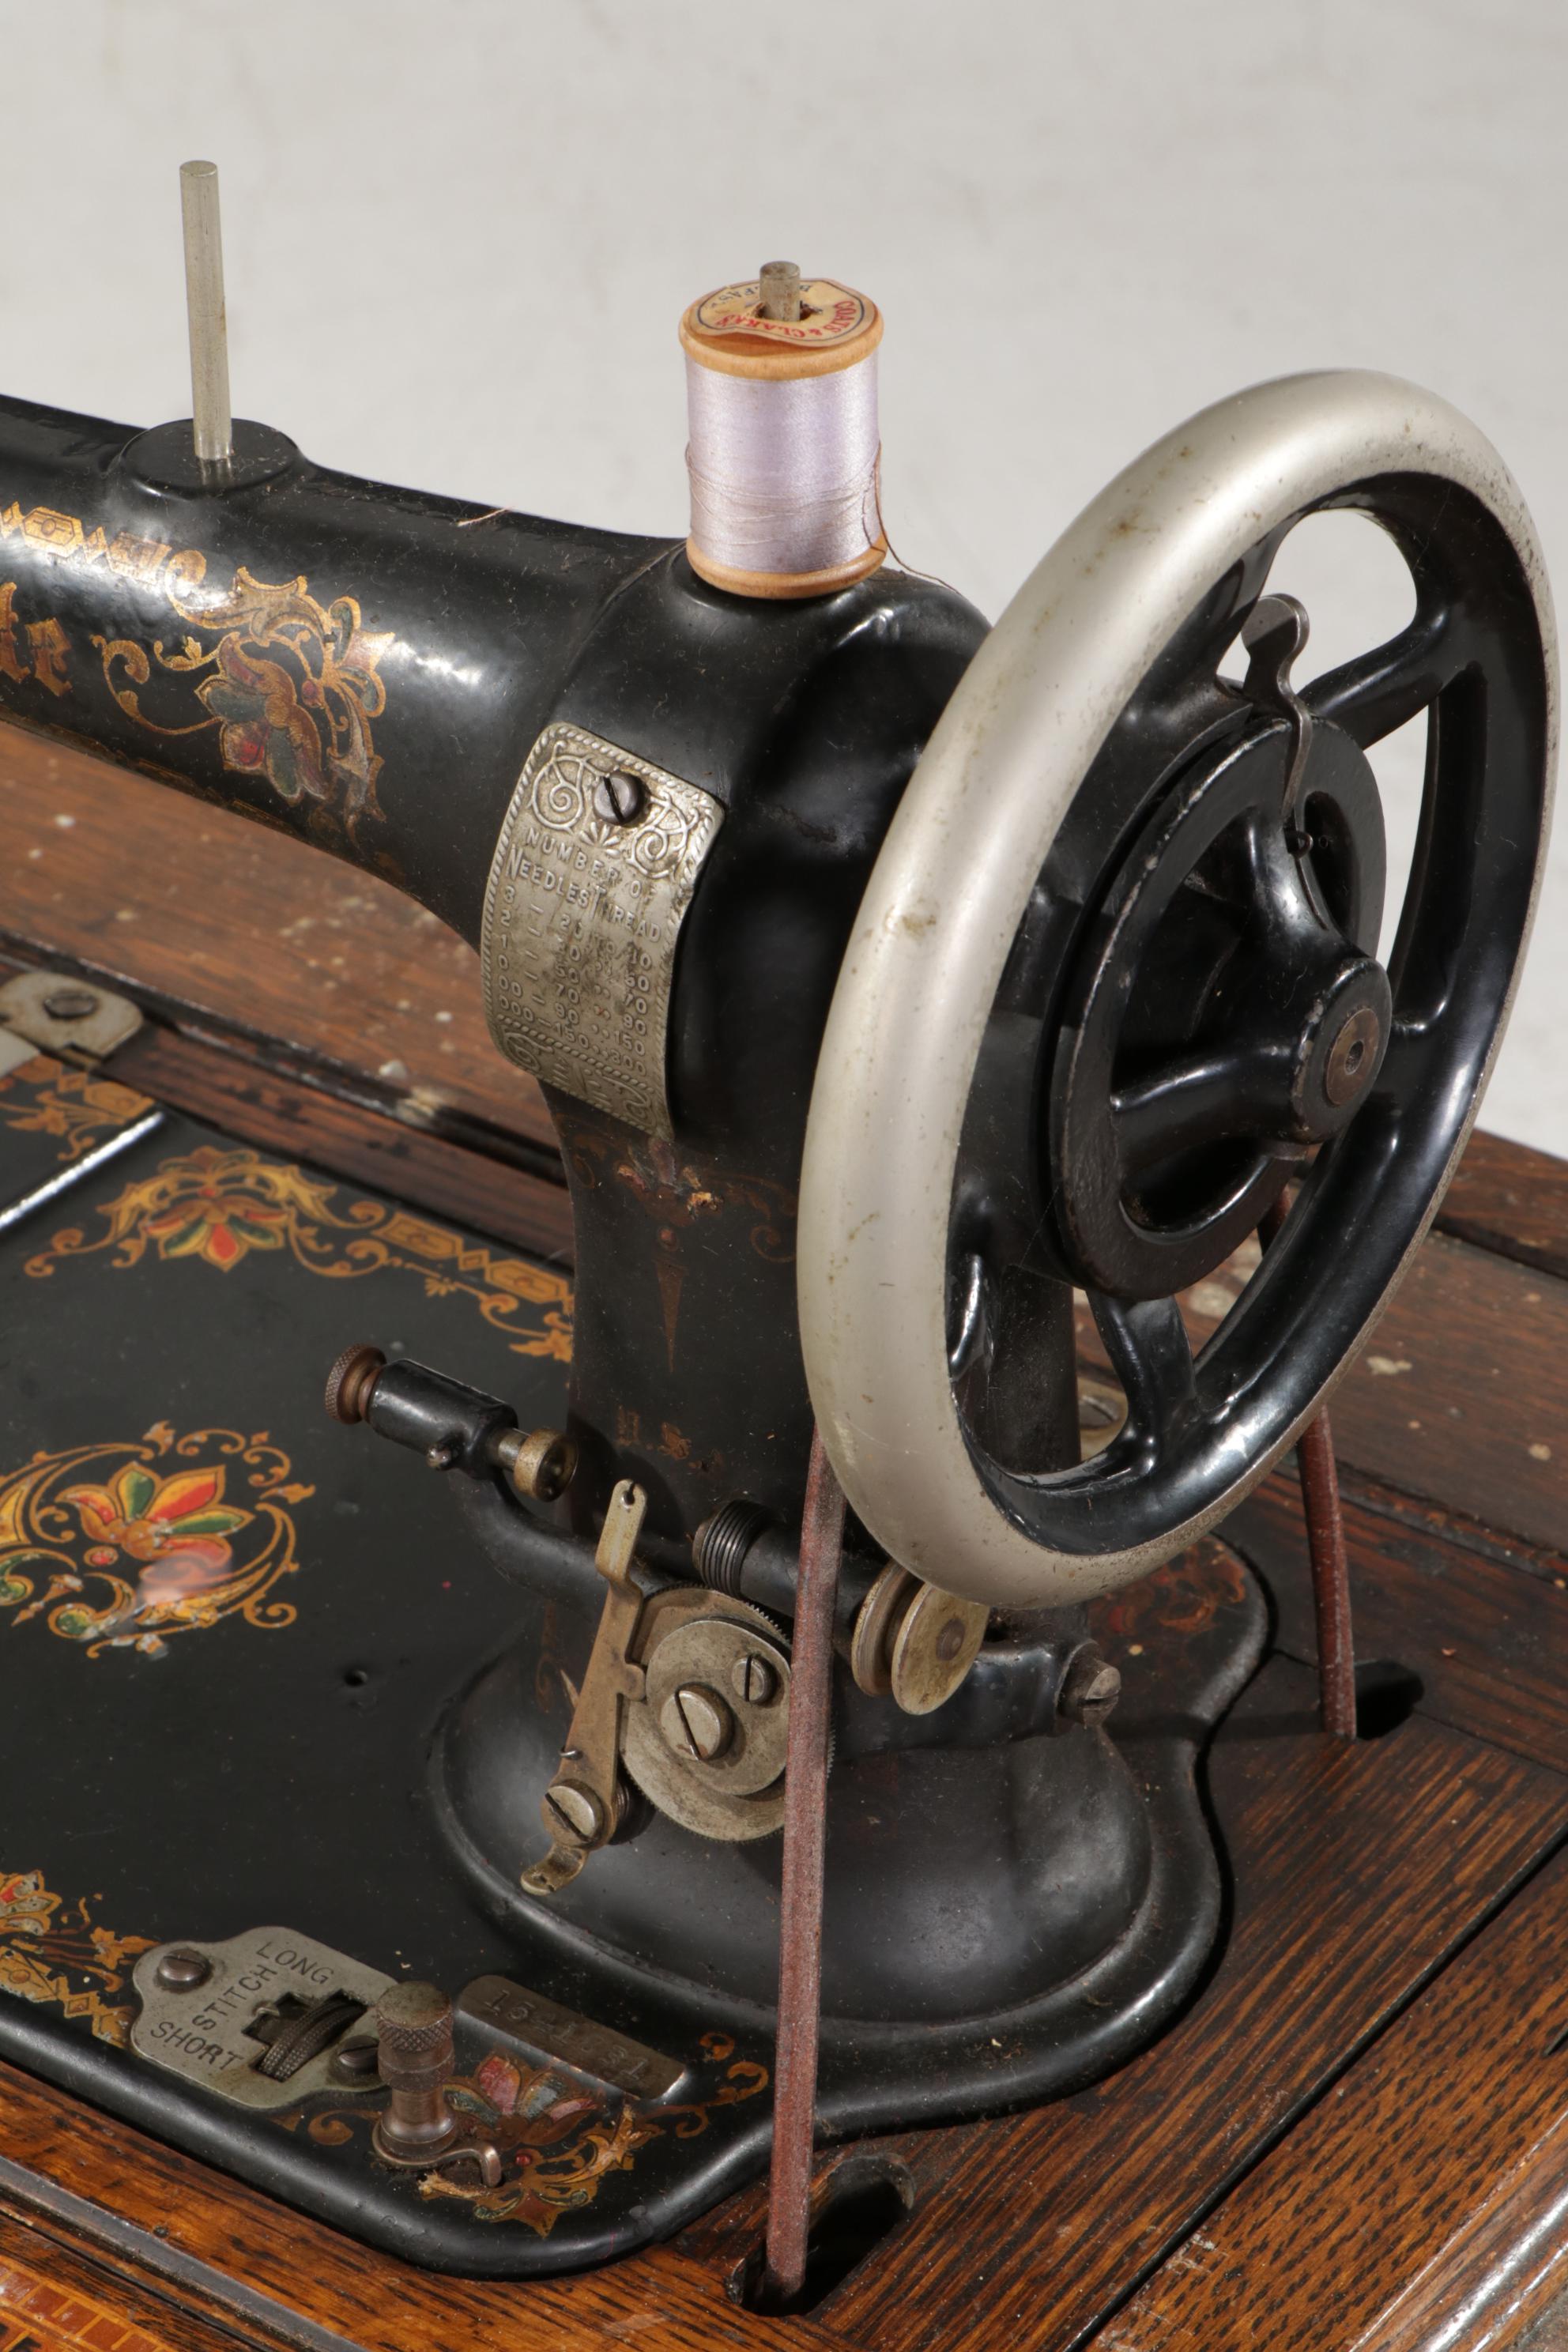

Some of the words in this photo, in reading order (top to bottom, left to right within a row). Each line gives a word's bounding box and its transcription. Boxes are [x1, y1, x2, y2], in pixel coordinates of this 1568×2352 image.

[824, 300, 857, 332] COATS
[506, 843, 590, 909] NEEDLES
[525, 827, 620, 886] NUMBER
[630, 879, 657, 905] OF
[500, 909, 511, 927] 2
[498, 954, 509, 971] 0
[499, 974, 523, 998] 00
[614, 1030, 646, 1057] 150
[499, 995, 534, 1023] 000
[555, 1022, 590, 1050] 150
[255, 1941, 335, 1985] LONG
[192, 1963, 278, 2031] STITCH
[150, 2021, 245, 2071] SHORT
